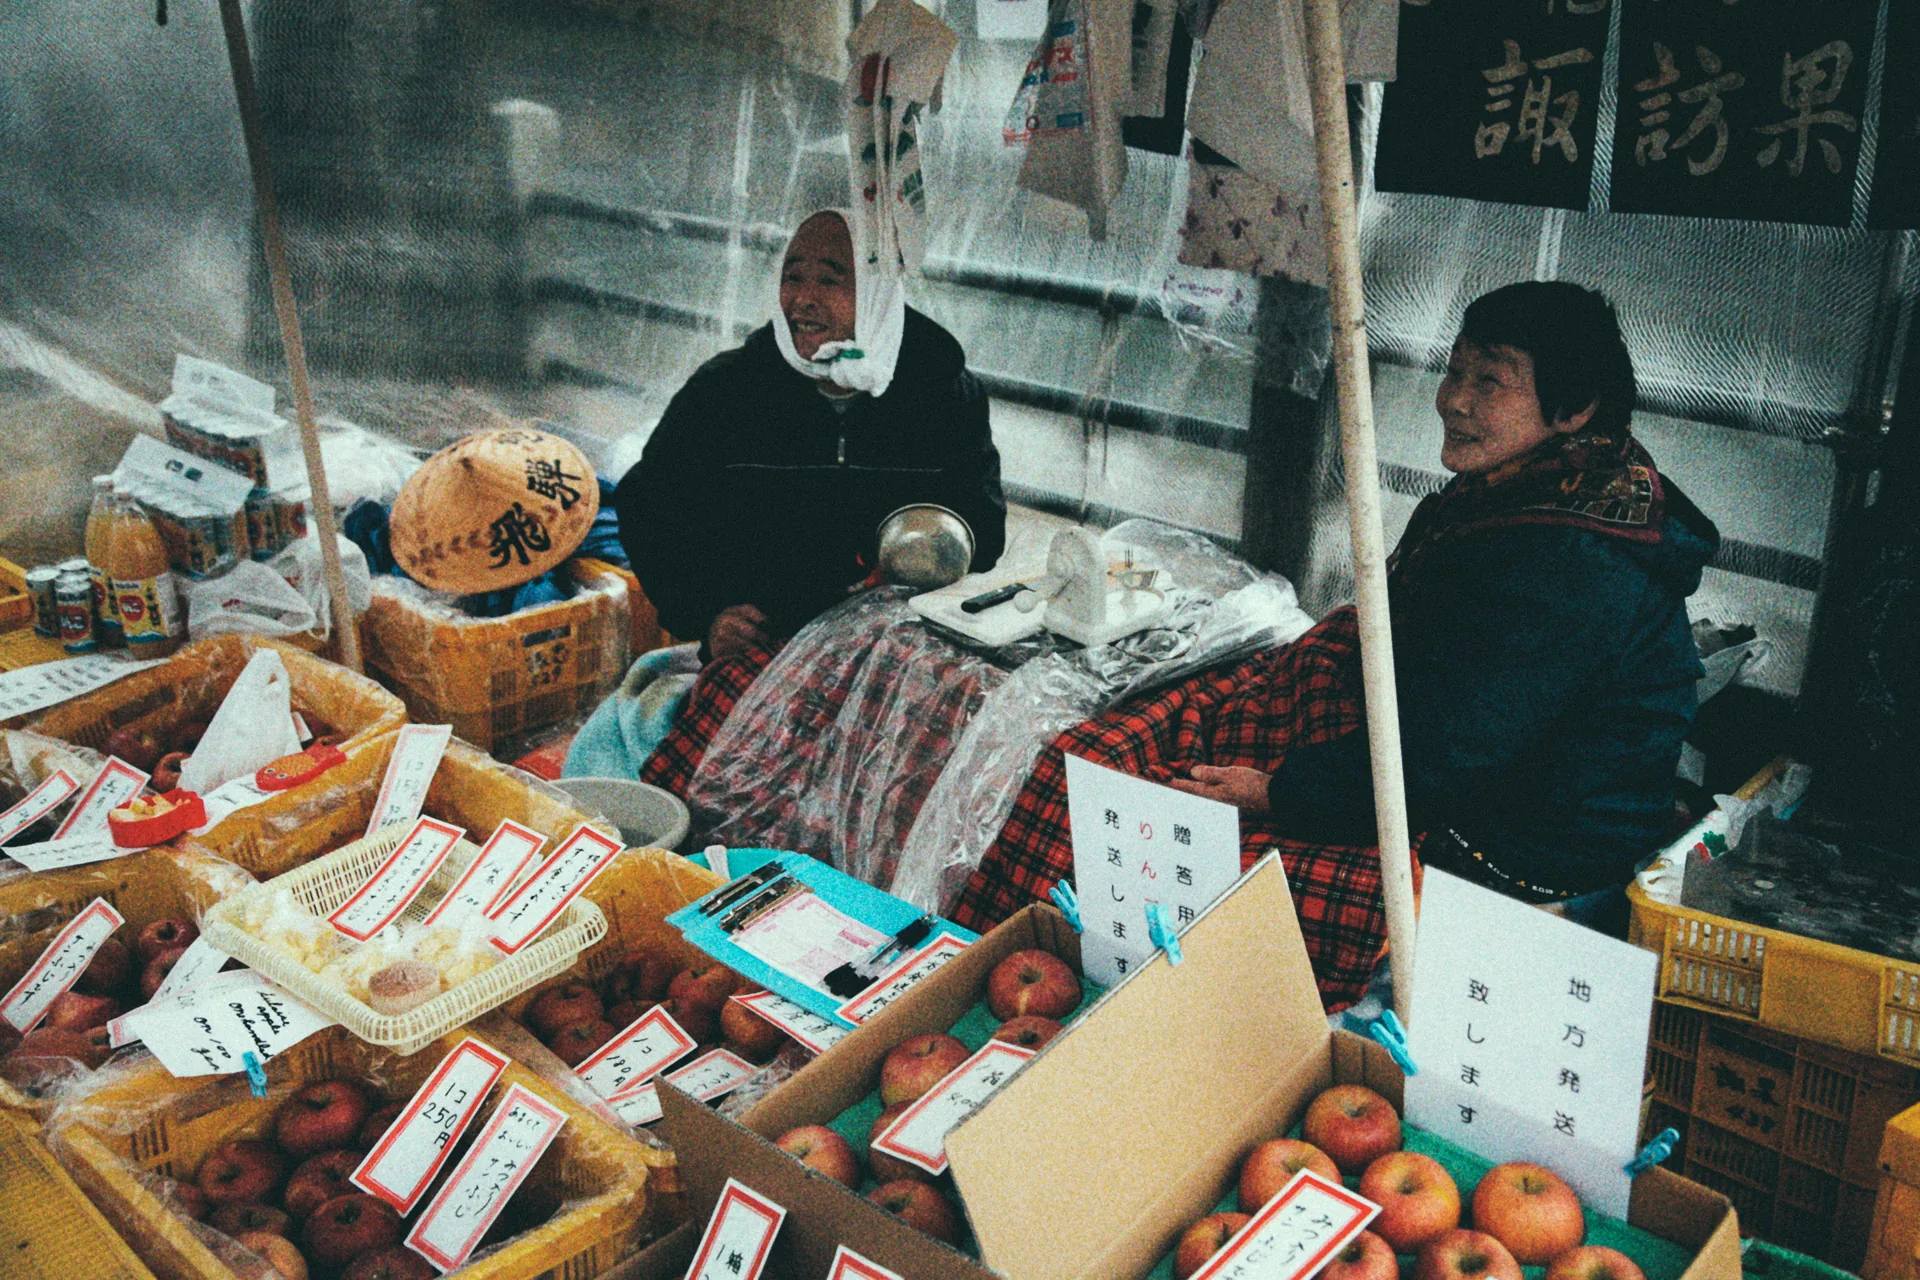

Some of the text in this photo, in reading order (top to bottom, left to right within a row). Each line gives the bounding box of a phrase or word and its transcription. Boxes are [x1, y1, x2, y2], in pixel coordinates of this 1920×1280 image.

[1104, 808, 1129, 973] 発送します
[1139, 820, 1160, 904] りん
[606, 1055, 632, 1074] 180
[1457, 978, 1490, 1124] 致します
[1554, 976, 1592, 1137] 地方発送
[423, 1101, 458, 1129] 250
[445, 1082, 467, 1104] 1コ
[433, 1131, 451, 1149] 円
[455, 1158, 499, 1218] サンふじ
[474, 1159, 517, 1216] みつ入り
